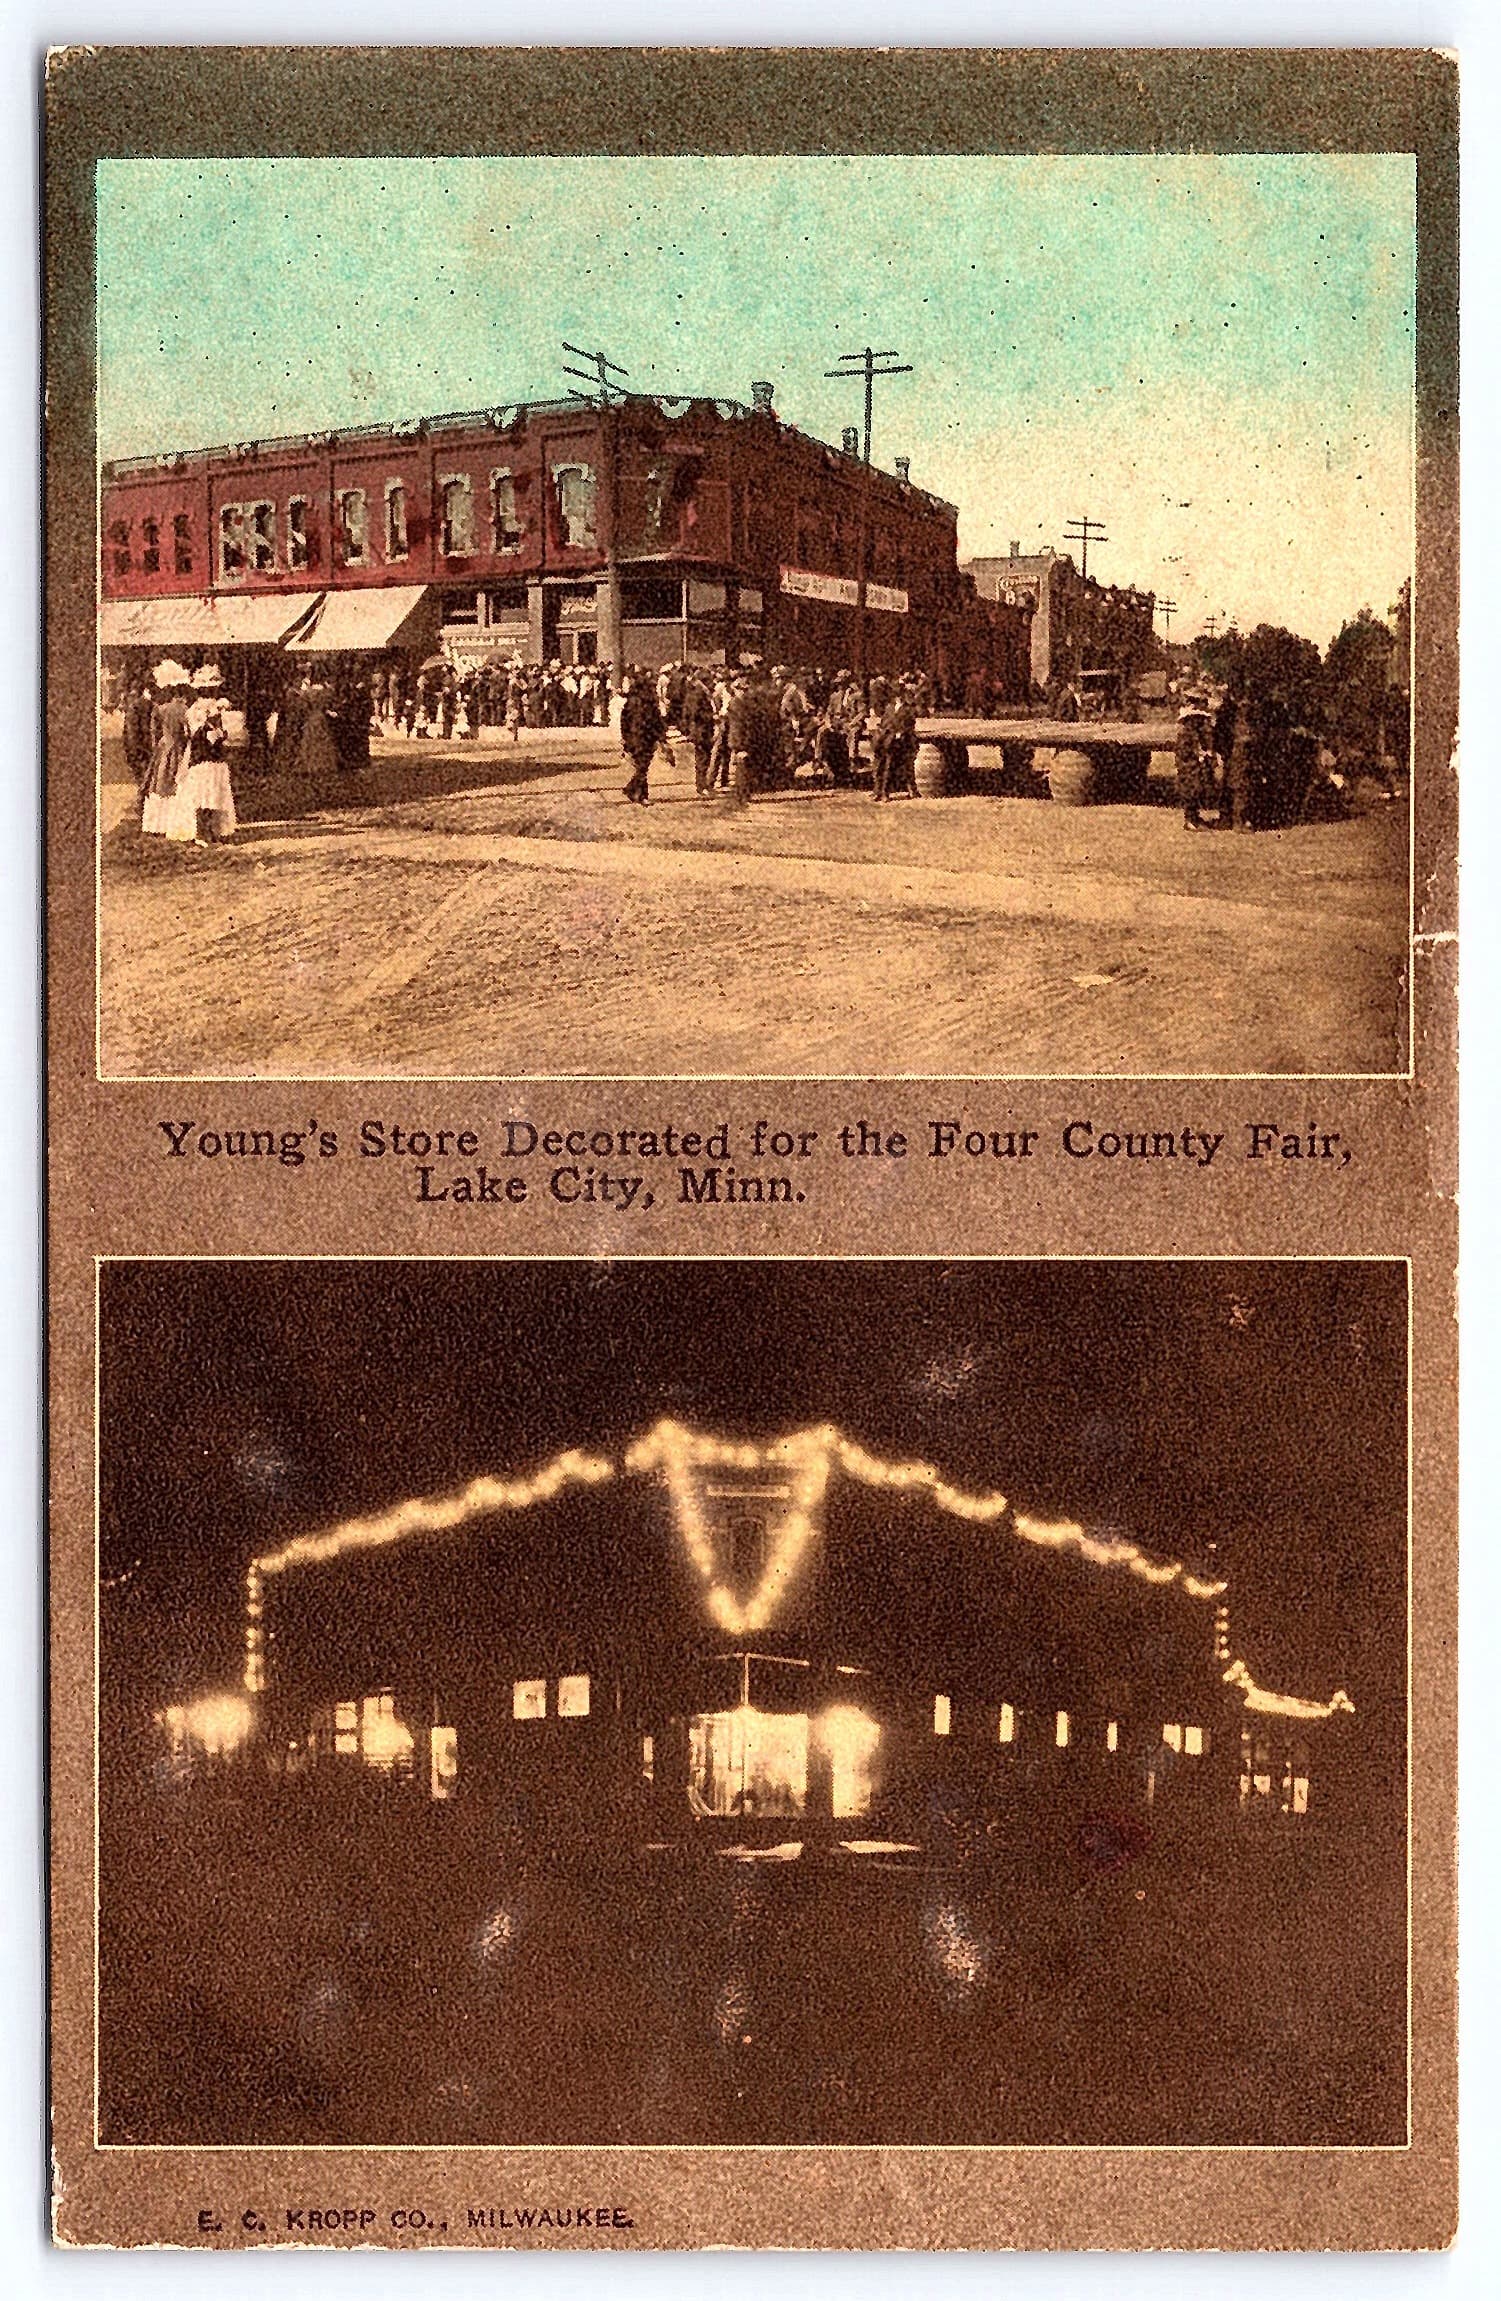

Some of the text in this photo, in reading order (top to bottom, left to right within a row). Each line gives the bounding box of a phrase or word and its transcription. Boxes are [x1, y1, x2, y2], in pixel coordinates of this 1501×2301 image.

[158, 1119, 1351, 1167] Young's Store Decorated for the Four County Fair,
[415, 1166, 805, 1211] Lake City, Minn.
[198, 2207, 634, 2232] E. C. KROPP CO., MILWAUKEE.
